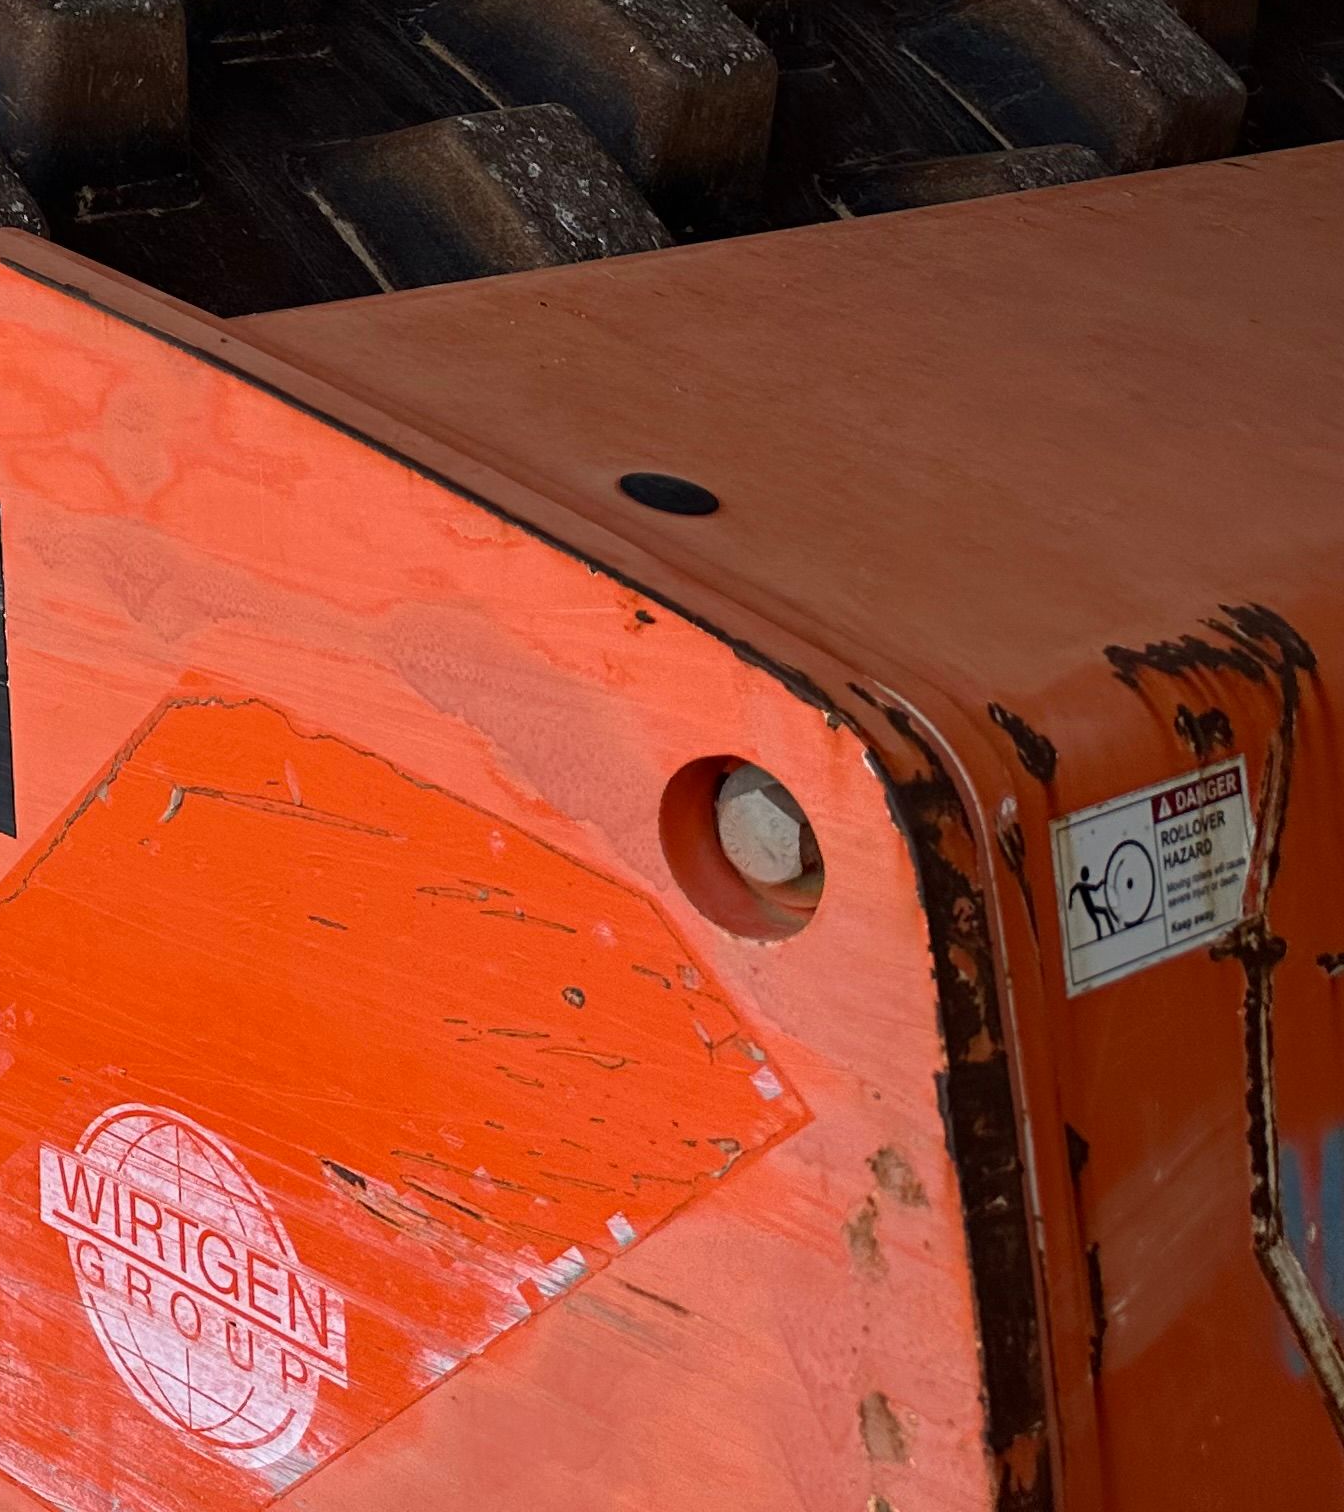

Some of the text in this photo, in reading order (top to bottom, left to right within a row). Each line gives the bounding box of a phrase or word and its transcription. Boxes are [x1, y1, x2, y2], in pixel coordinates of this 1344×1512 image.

[1175, 773, 1237, 811] DANGER
[1160, 810, 1226, 848] ROLLOVER
[1163, 838, 1212, 871] HAZARD
[57, 1155, 329, 1350] WIRTGEN
[76, 1239, 309, 1394] GROUP
